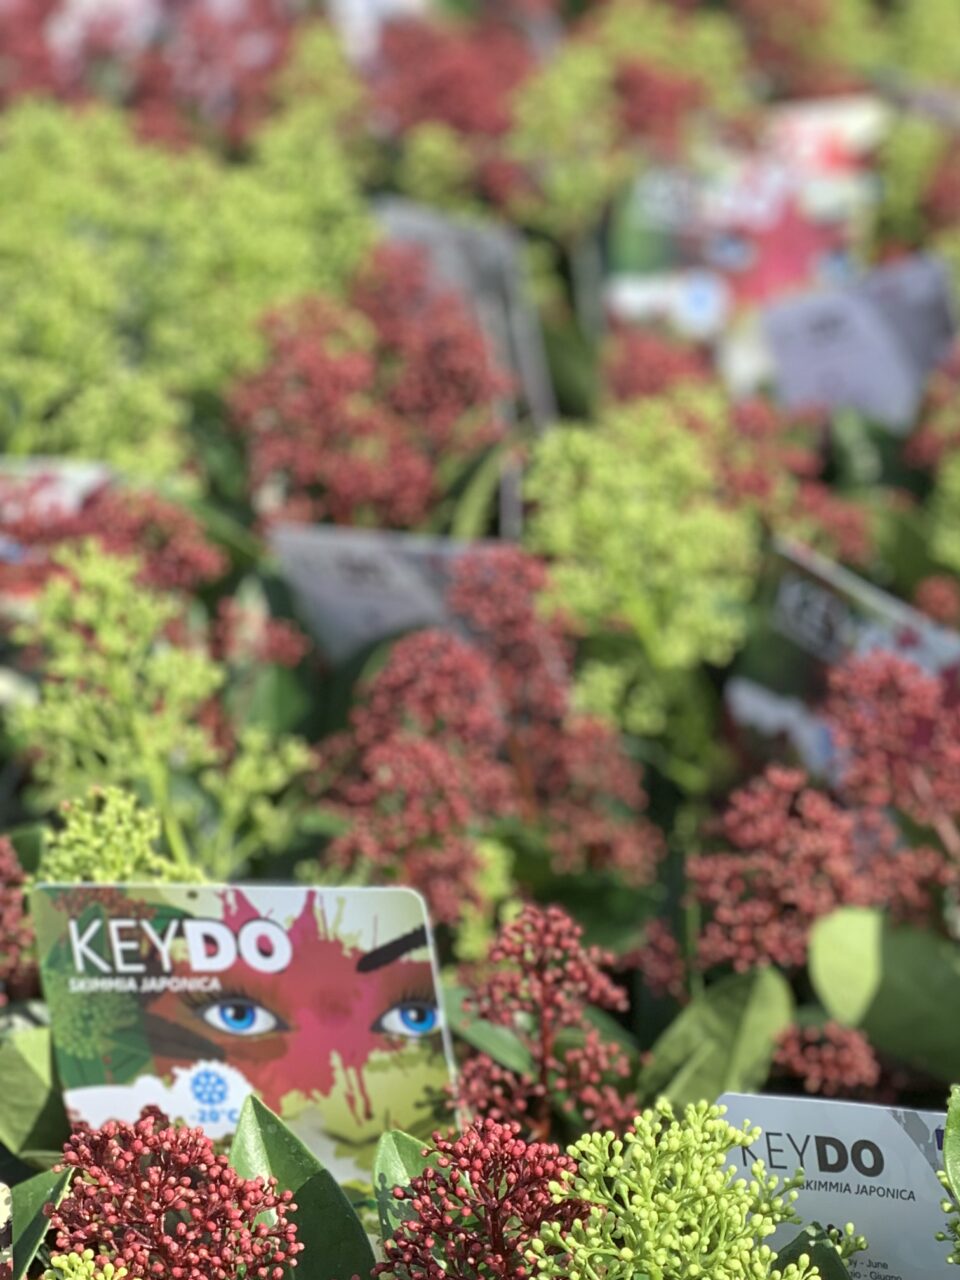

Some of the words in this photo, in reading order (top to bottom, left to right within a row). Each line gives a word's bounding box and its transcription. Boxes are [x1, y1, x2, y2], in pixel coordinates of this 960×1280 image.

[68, 918, 293, 974] KEYDO
[69, 976, 138, 993] SKIMMIA
[141, 976, 222, 993] JAPONICA
[854, 1183, 917, 1202] JAPONICA
[866, 1259, 889, 1270] June
